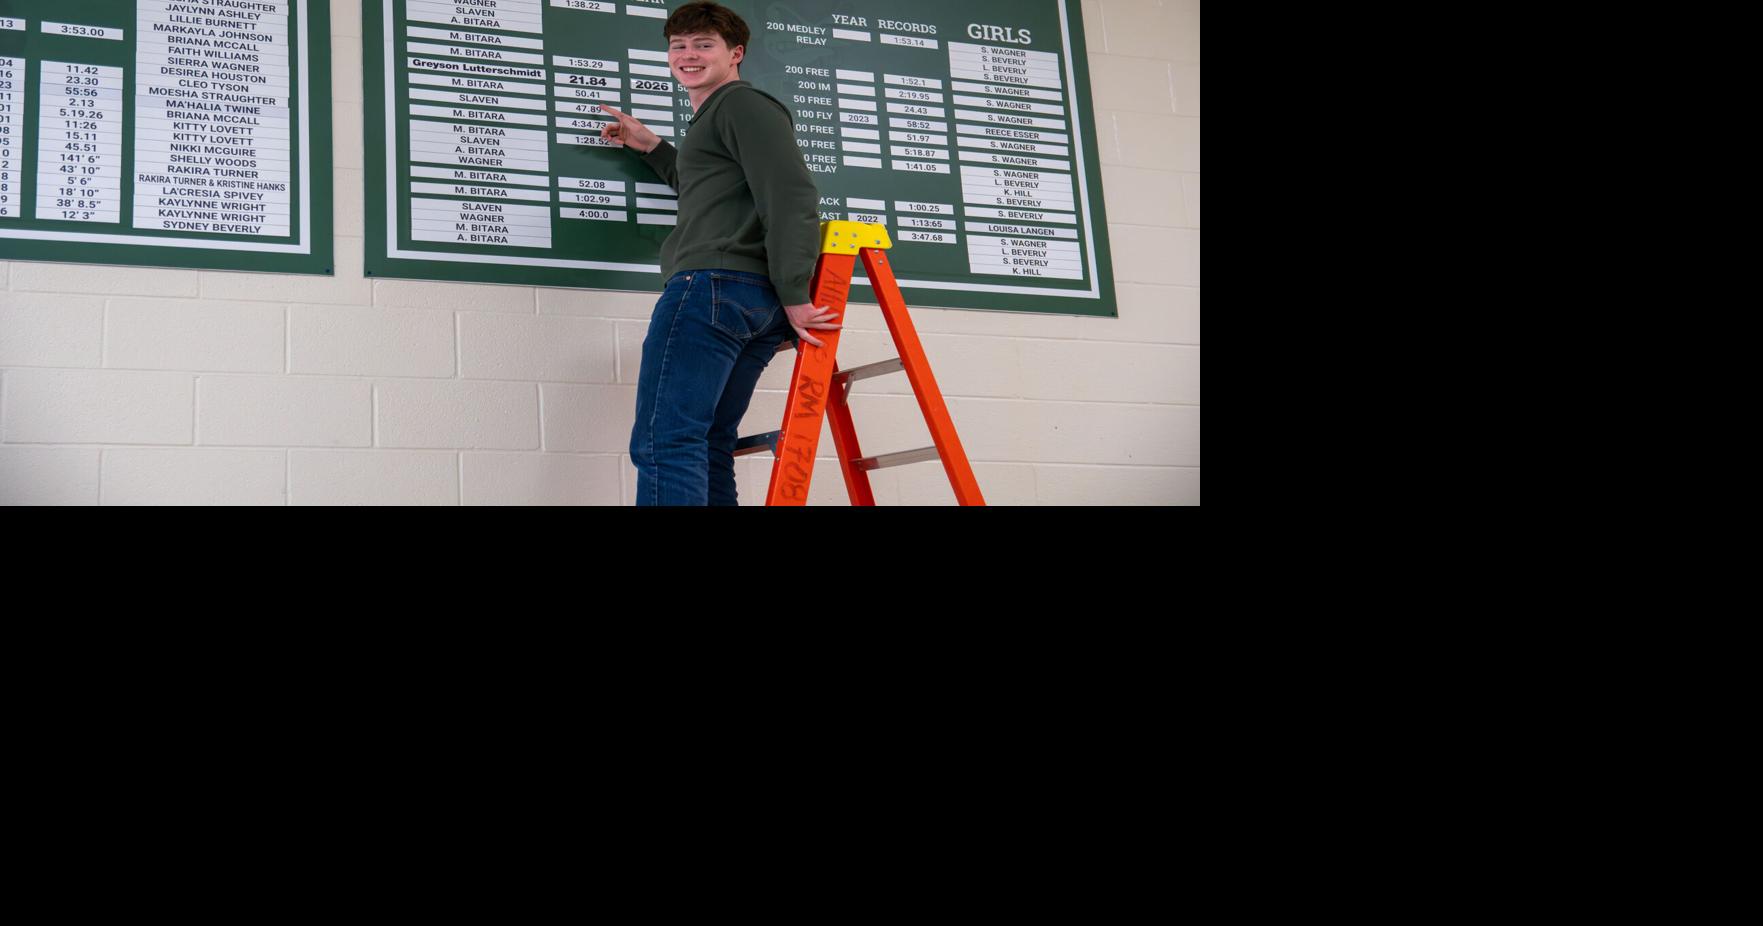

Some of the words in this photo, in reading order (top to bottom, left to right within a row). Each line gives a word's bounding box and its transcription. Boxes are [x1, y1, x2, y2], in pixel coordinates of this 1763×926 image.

[566, 0, 600, 9] 1:38.22
[165, 4, 215, 15] JAYLYNN
[219, 10, 261, 20] ASHLEY
[456, 7, 495, 17] SLAVEN
[170, 15, 202, 24] LILLIE
[205, 18, 256, 30] BURNETT
[464, 18, 500, 27] BITARA
[832, 14, 867, 26] YEAR
[878, 19, 937, 34] RECORDS
[61, 26, 104, 37] 3:53.00
[154, 24, 216, 36] MARKAYLA
[219, 31, 272, 42] JOHNSON
[767, 22, 784, 31] 200
[787, 24, 826, 35] MEDLEY
[968, 23, 1031, 44] GIRLS
[168, 36, 210, 47] BRIANA
[214, 40, 259, 51] MCCALL
[465, 34, 501, 44] BITARA
[796, 36, 827, 46] RELAY
[894, 37, 924, 46] 1:53.14
[169, 46, 200, 56] FAITH
[204, 50, 259, 62] WILLIAMS
[991, 48, 1026, 57] WAGNER
[168, 57, 208, 68] SIERRA
[212, 62, 260, 72] WAGNER
[413, 59, 459, 70] Greyson
[463, 64, 541, 77] Lutterschmidt
[569, 59, 603, 68] 1:53.29
[66, 66, 98, 75] 11.42
[161, 67, 208, 78] DESIREA
[212, 72, 266, 83] HOUSTON
[785, 66, 803, 74] 200
[806, 68, 830, 76] FREE
[992, 66, 1026, 74] BEVERLY
[66, 76, 98, 86] 23.30
[179, 79, 208, 88] CLEO
[212, 82, 249, 92] TYSON
[570, 76, 607, 86] 21.84
[636, 81, 669, 91] 2026
[798, 81, 815, 89] 200
[901, 78, 926, 86] 1:52.1
[65, 87, 98, 97] 55:56
[149, 87, 198, 98] MOESHA
[202, 91, 276, 105] STRAUGHTER
[899, 91, 930, 100] 2:19.95
[69, 98, 94, 107] 2.13
[459, 95, 498, 104] SLAVEN
[808, 96, 832, 105] FREE
[166, 100, 222, 111] MA'HALIA
[224, 105, 261, 114] TWINE
[576, 105, 602, 113] 47.89
[904, 106, 927, 114] 24.43
[60, 109, 103, 119] 5.19.26
[167, 111, 210, 121] BRIANA
[214, 115, 260, 125] MCCALL
[796, 110, 814, 118] 100
[817, 111, 832, 120] FLY
[65, 121, 97, 130] 11:26
[173, 122, 207, 132] KITTY
[211, 125, 253, 135] LOVETT
[810, 125, 834, 134] FREE
[907, 121, 930, 129] 58:52
[66, 132, 96, 140] 15.11
[469, 127, 505, 136] BITARA
[986, 128, 1011, 136] REECE
[1014, 130, 1039, 139] ESSER
[173, 133, 206, 143] KITTY
[210, 136, 253, 146] LOVETT
[460, 136, 500, 145] SLAVEN
[812, 140, 835, 149] FREE
[65, 143, 96, 152] 45.51
[170, 144, 200, 153] NIKKI
[204, 146, 256, 157] MCGUIRE
[468, 147, 505, 156] BITARA
[905, 149, 935, 157] 5:18.87
[170, 155, 212, 165] SHELLY
[215, 158, 257, 168] WOODS
[459, 156, 502, 166] WAGNER
[813, 155, 836, 164] FREE
[168, 165, 210, 176] RAKIRA
[213, 168, 258, 178] TURNER
[806, 164, 837, 173] RELAY
[906, 163, 936, 171] 1:41.05
[1004, 171, 1038, 179] WAGNER
[139, 174, 171, 184] RAKIRA
[173, 177, 206, 186] TURNER
[217, 180, 254, 190] KRISTINE
[257, 183, 285, 191] HANKS
[163, 188, 220, 198] LA'CRESIA
[224, 191, 263, 200] SPIVEY
[576, 195, 610, 203] 1:02.99
[159, 198, 218, 209] KAYLYNNE
[221, 202, 266, 212] WRIGHT
[462, 203, 502, 212] SLAVEN
[909, 204, 940, 212] 1:00.25
[159, 209, 218, 220] KAYLYNNE
[221, 213, 266, 223] WRIGHT
[460, 213, 504, 222] WAGNER
[163, 221, 209, 231] SYDNEY
[212, 224, 261, 233] BEVERLY
[912, 219, 942, 227] 1:13:65
[472, 225, 508, 233] BITARA
[989, 225, 1019, 233] LOUISA
[1021, 226, 1054, 235] LANGEN
[471, 235, 508, 243] BITARA
[912, 233, 943, 241] 3:47.68
[1012, 249, 1046, 257] BEVERLY
[794, 374, 824, 418] RM
